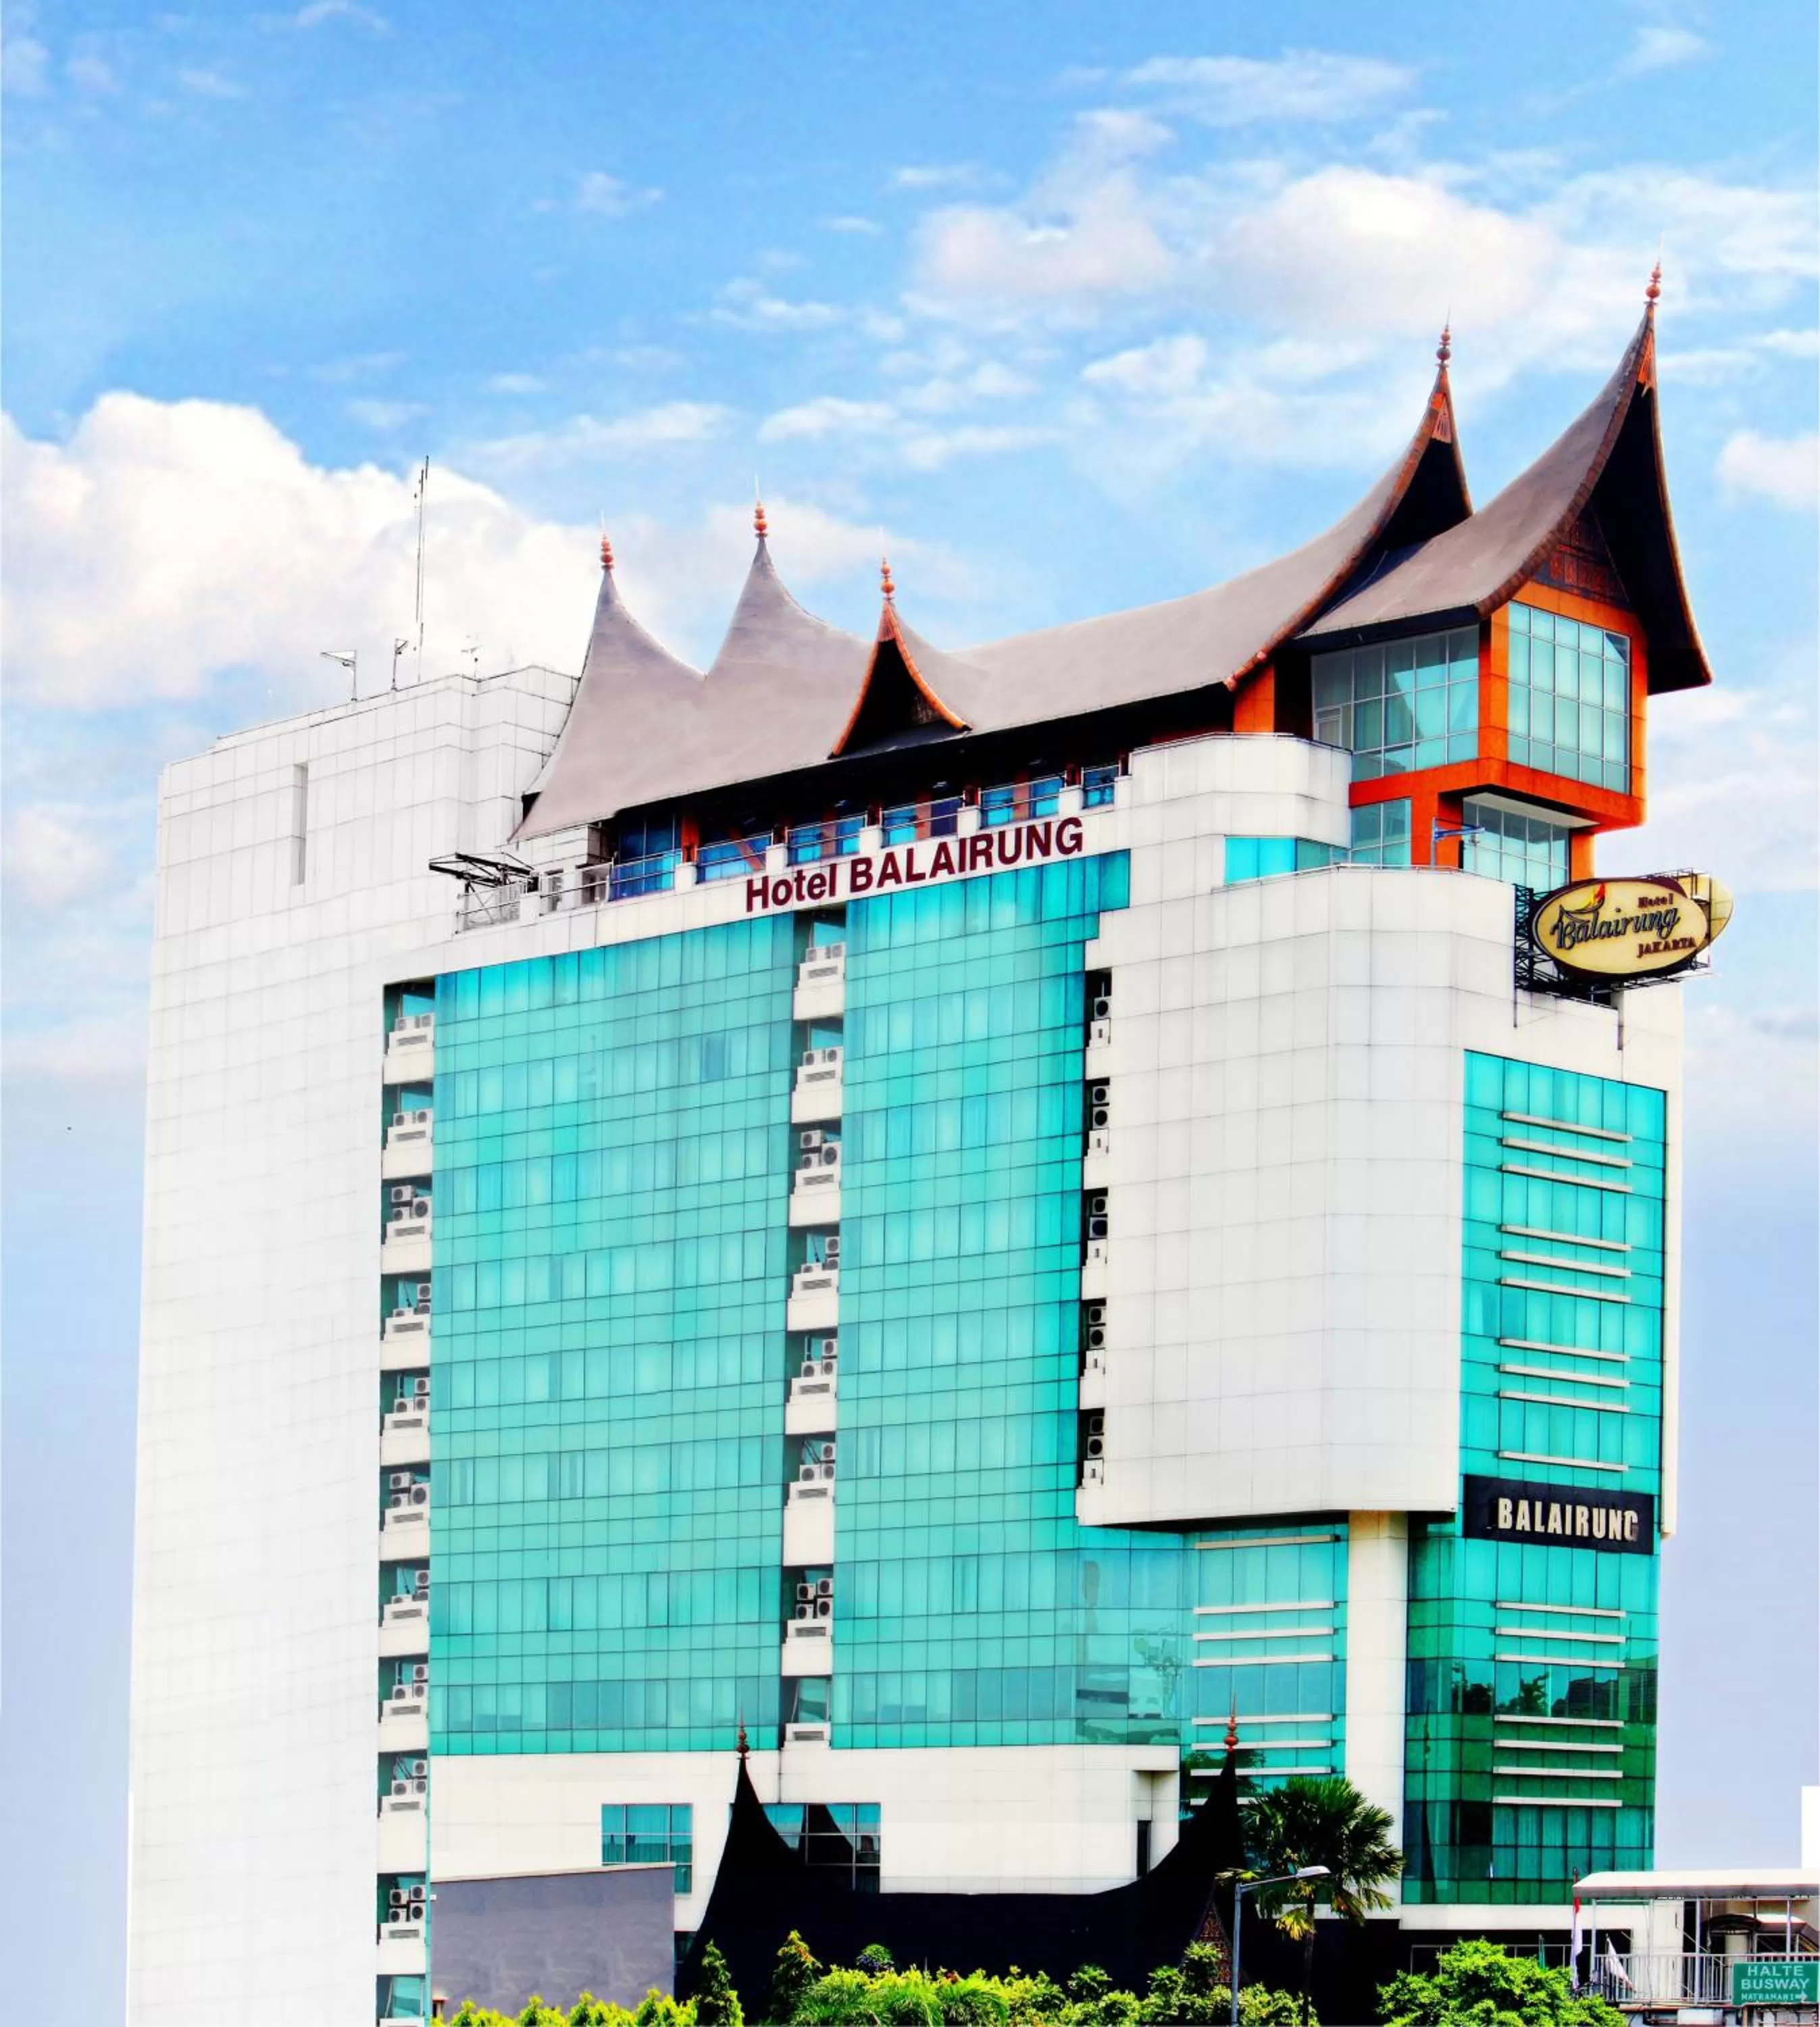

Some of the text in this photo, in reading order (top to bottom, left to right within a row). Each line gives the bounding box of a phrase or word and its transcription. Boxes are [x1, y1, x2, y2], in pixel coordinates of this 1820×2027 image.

[747, 817, 1084, 912] Hotel BALAIRUNG
[1638, 893, 1673, 908] Hotel
[1550, 904, 1680, 950] Balairung
[1636, 937, 1696, 958] JAKARTA
[1498, 1498, 1638, 1541] BALAIRUNG
[1747, 1966, 1804, 1976] HALTE
[1741, 1978, 1810, 1990] BUSWAY
